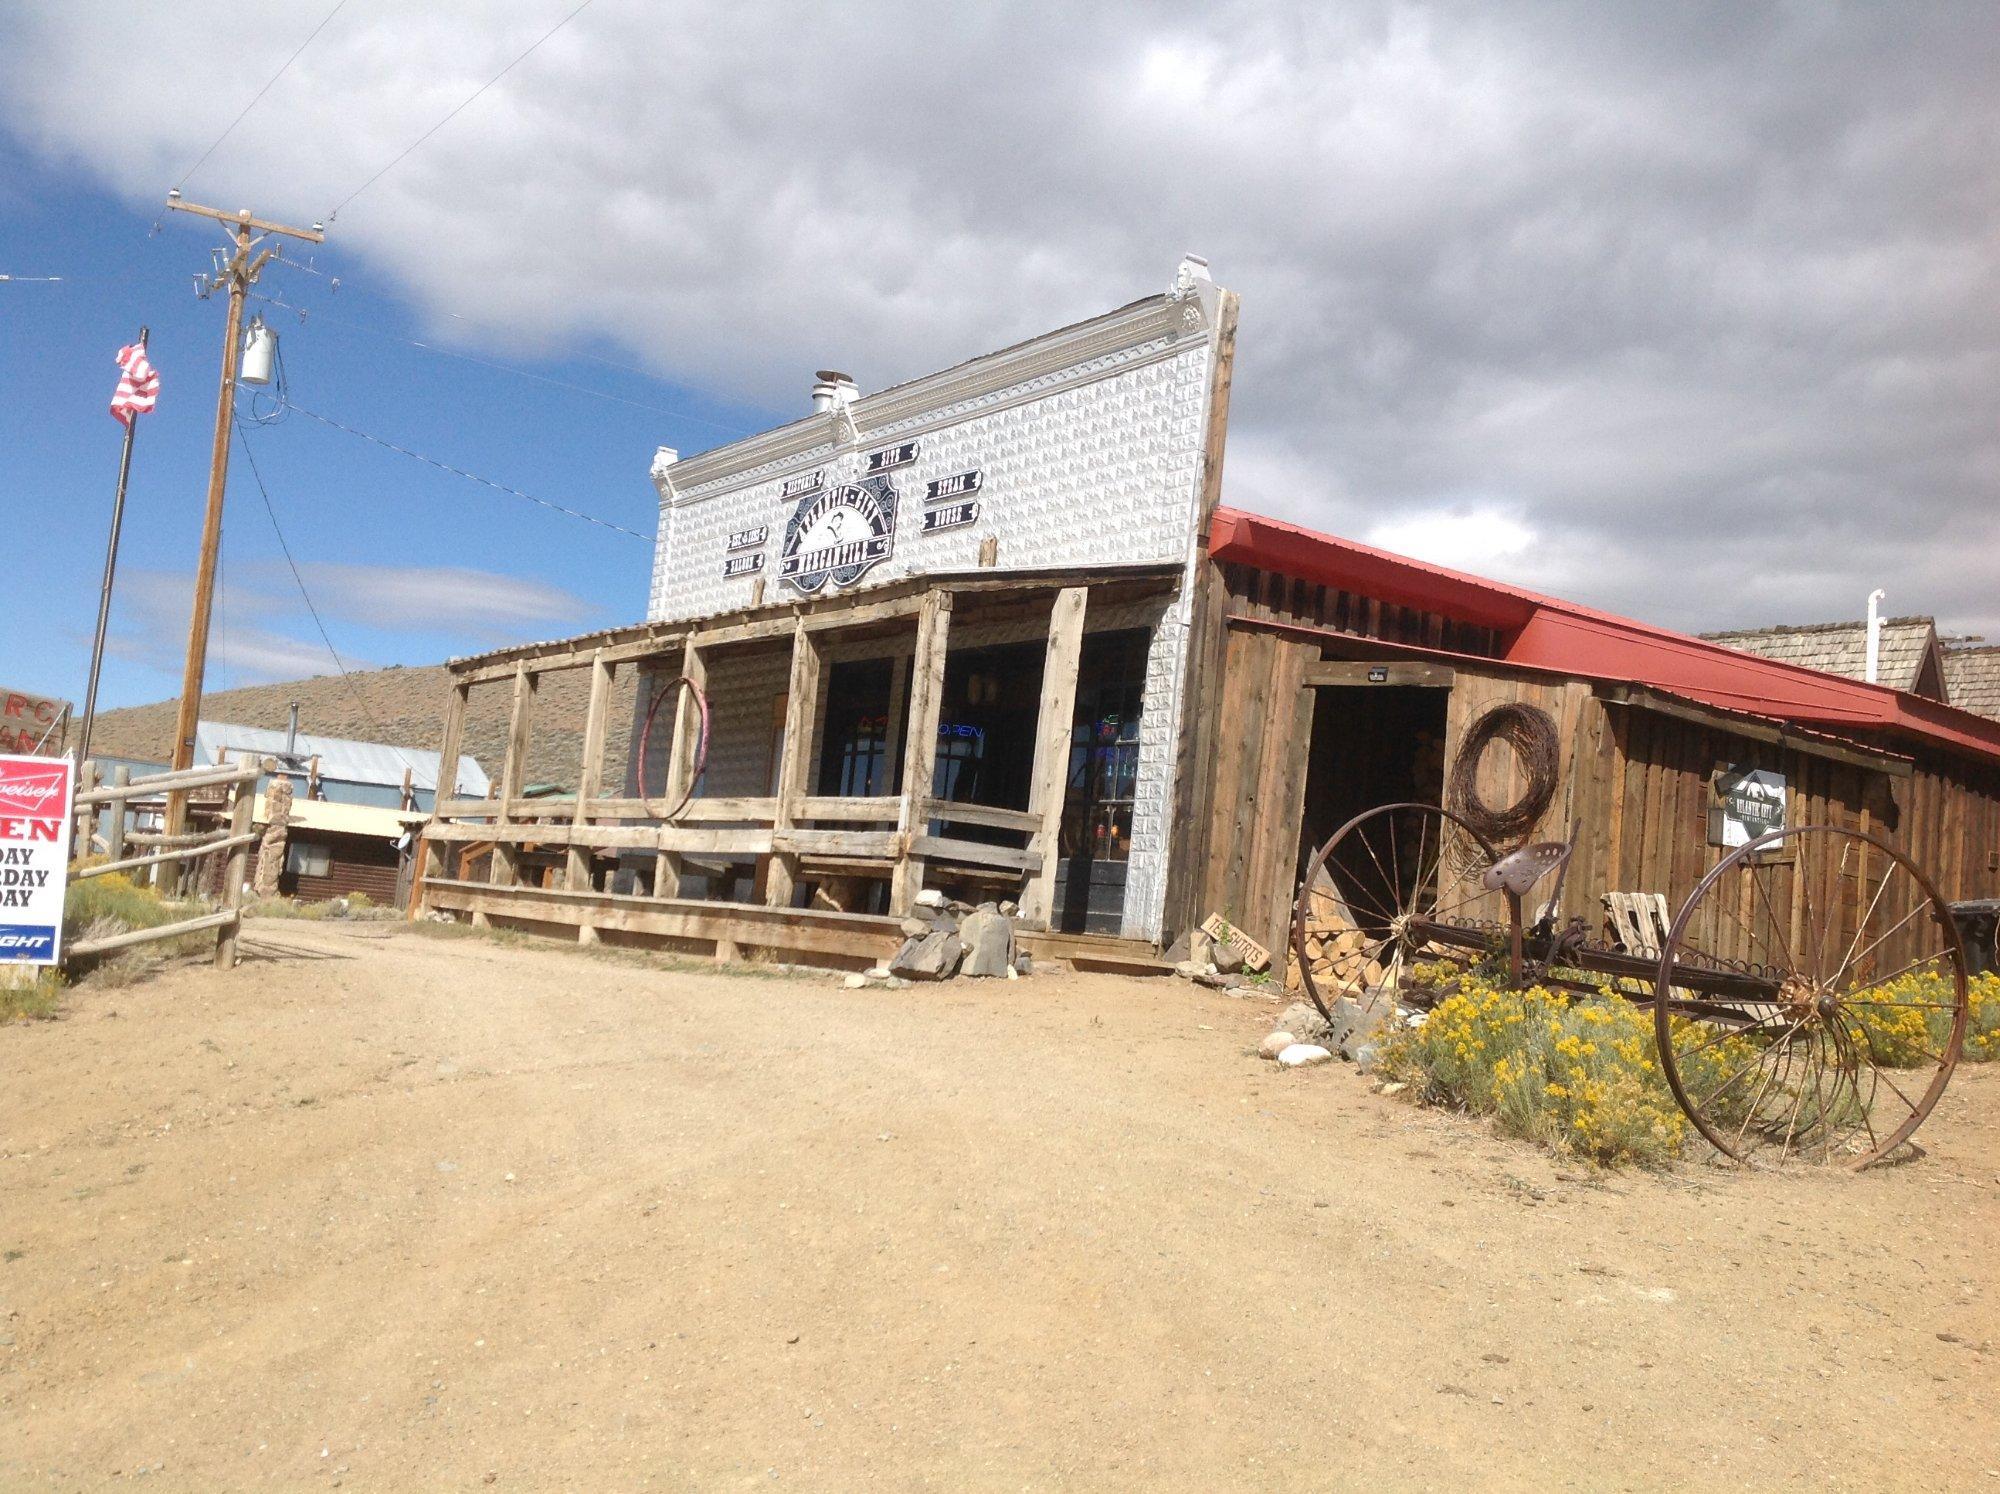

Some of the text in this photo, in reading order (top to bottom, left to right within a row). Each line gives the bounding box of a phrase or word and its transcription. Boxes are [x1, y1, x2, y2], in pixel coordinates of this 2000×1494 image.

[881, 447, 900, 467] SITE
[937, 475, 965, 496] STEAK
[795, 486, 880, 555] ATLANTIC CITY
[934, 506, 962, 527] HOUSE
[731, 556, 754, 574] SALOON
[796, 540, 869, 574] MERCANTILE
[938, 723, 983, 738] OPEN
[0, 869, 49, 887] DAY
[1230, 932, 1262, 963] SHIRTS
